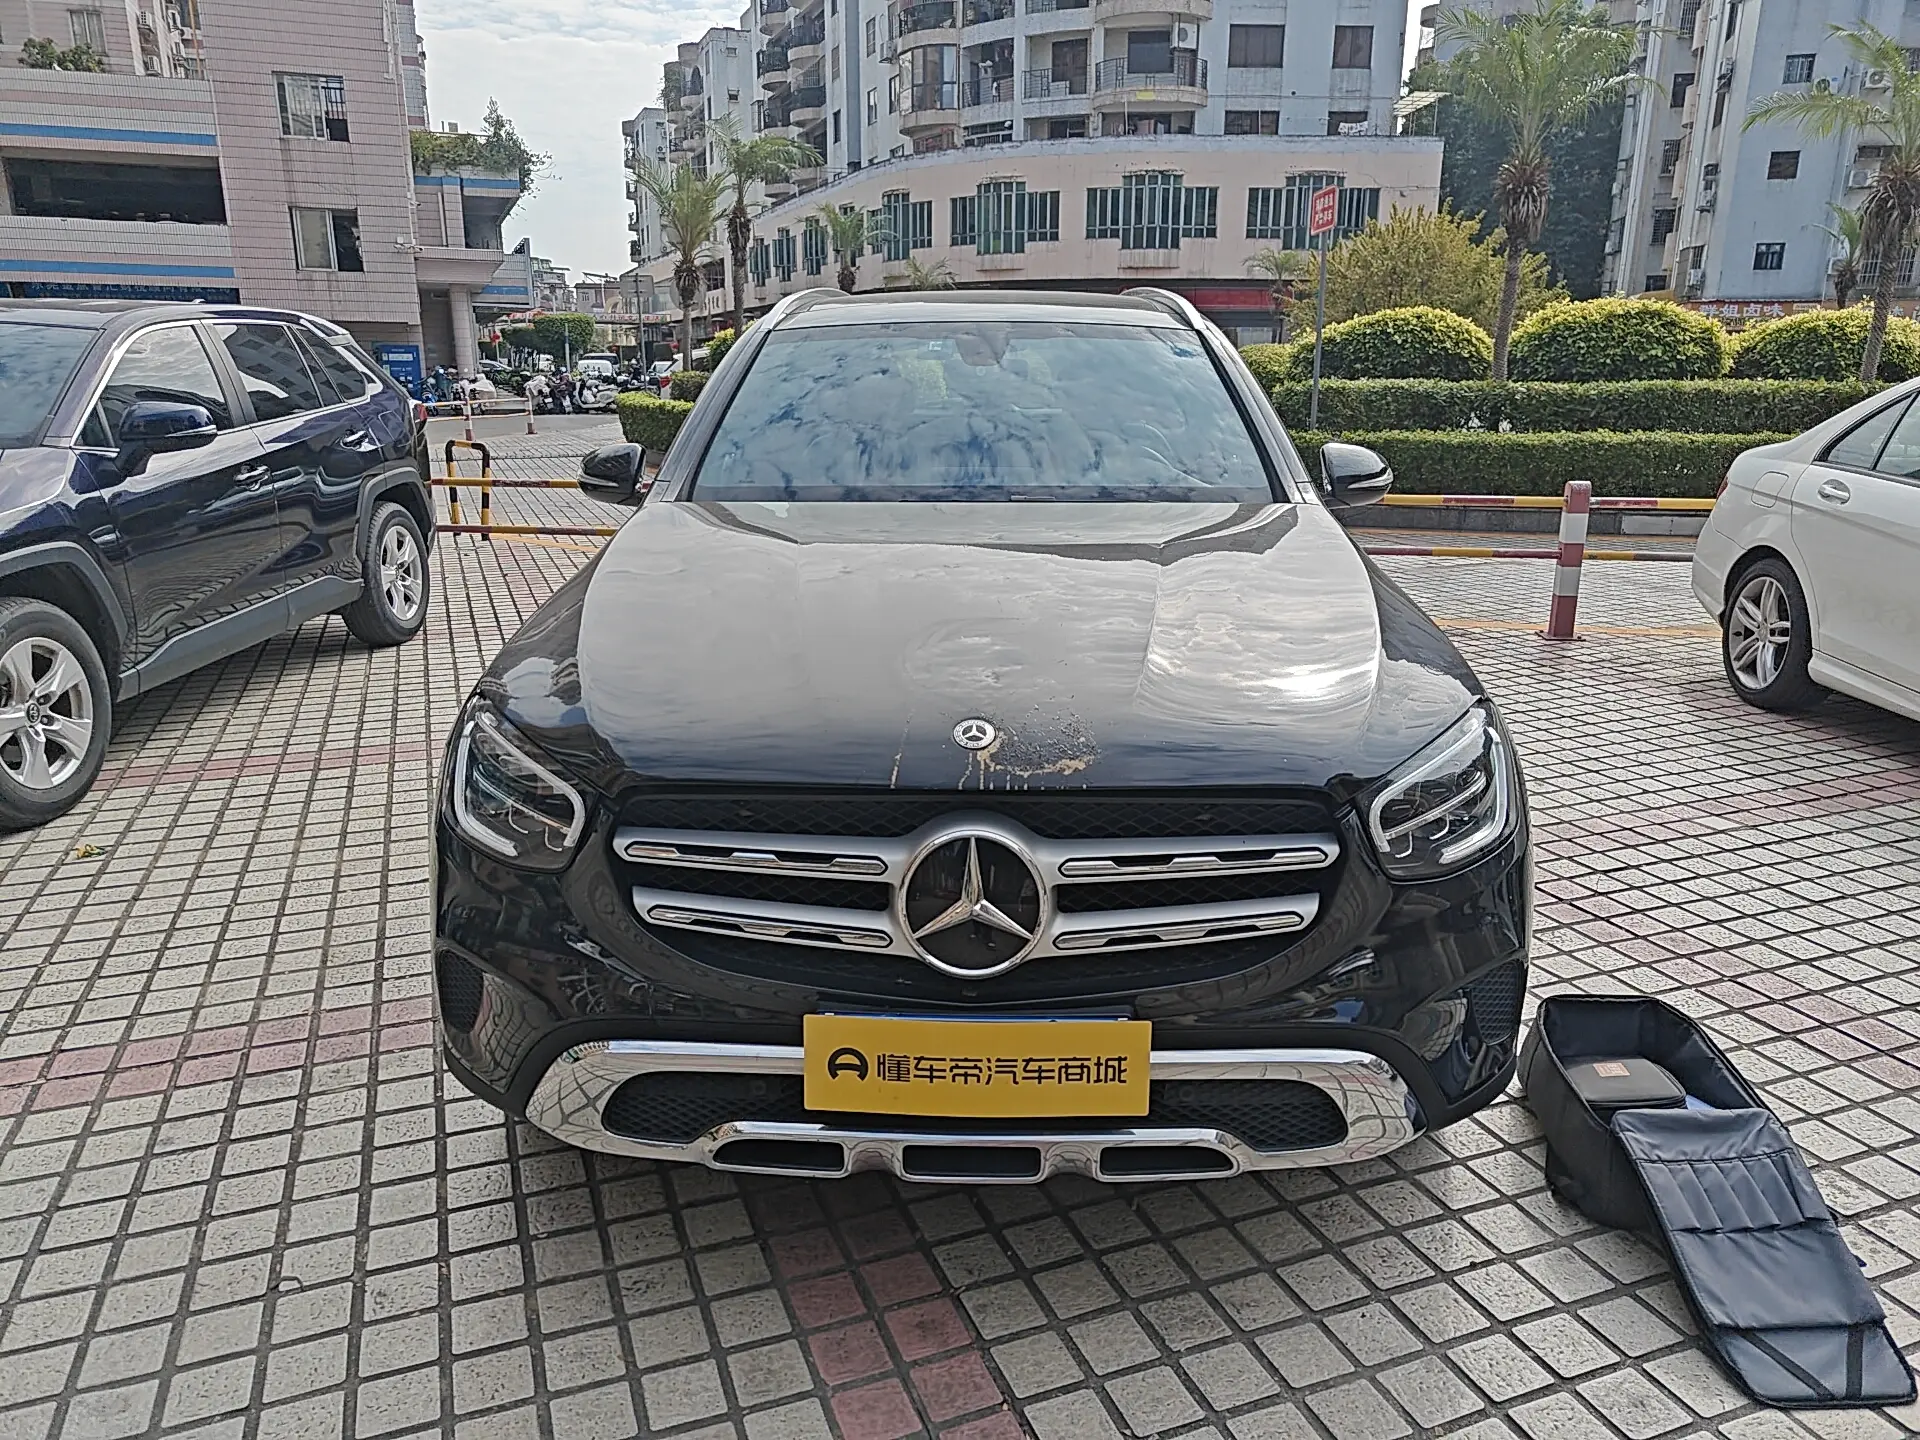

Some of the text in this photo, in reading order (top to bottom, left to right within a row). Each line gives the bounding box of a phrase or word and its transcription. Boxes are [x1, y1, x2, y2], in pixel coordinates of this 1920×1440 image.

[876, 1053, 1129, 1085] 懂车帝汽车商城
